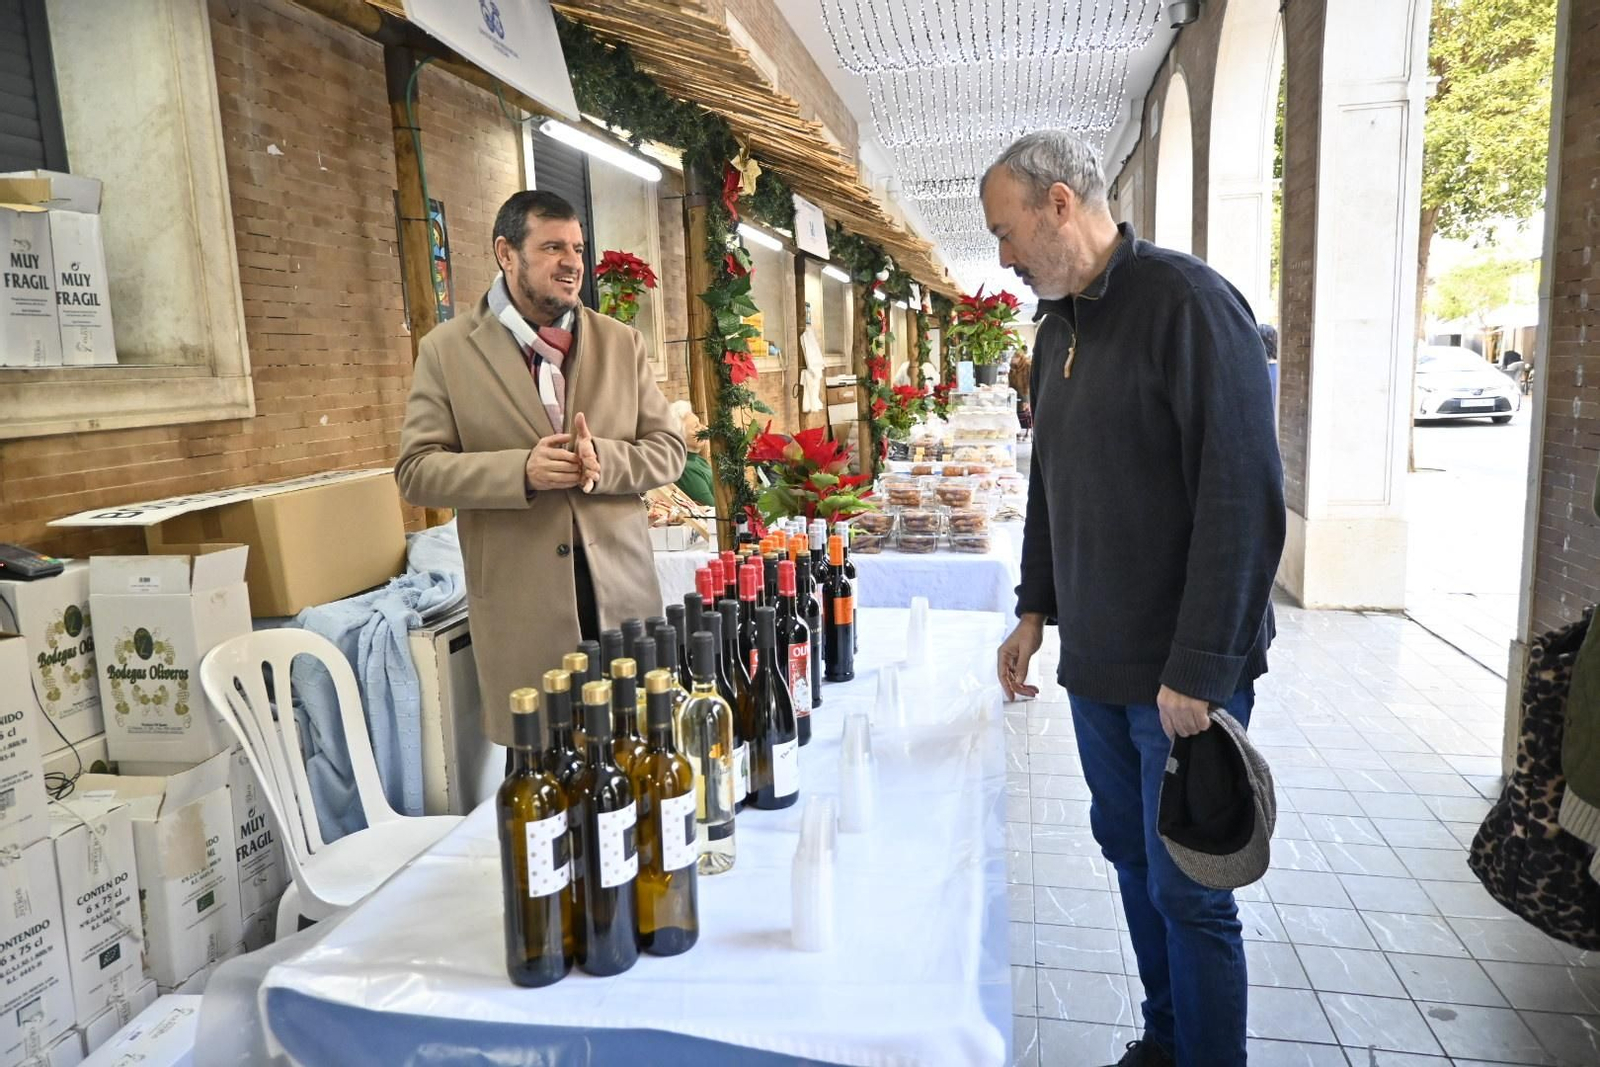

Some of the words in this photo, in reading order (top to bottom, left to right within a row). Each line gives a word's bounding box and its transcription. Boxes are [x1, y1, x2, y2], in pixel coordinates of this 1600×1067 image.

[10, 252, 39, 269] MUY
[3, 272, 50, 290] FRAGIL
[61, 272, 91, 287] MUY
[56, 291, 101, 306] FRAGIL
[38, 645, 77, 669] Bodegas
[107, 664, 147, 684] Bodegas
[150, 663, 189, 681] Oliveros
[240, 813, 265, 839] MUY
[236, 830, 274, 862] FRAGIL
[77, 872, 128, 906] CONTENDO
[86, 905, 92, 914] 6
[102, 893, 113, 905] 75
[114, 887, 122, 898] cl
[19, 942, 32, 956] 75
[34, 936, 43, 948] cl
